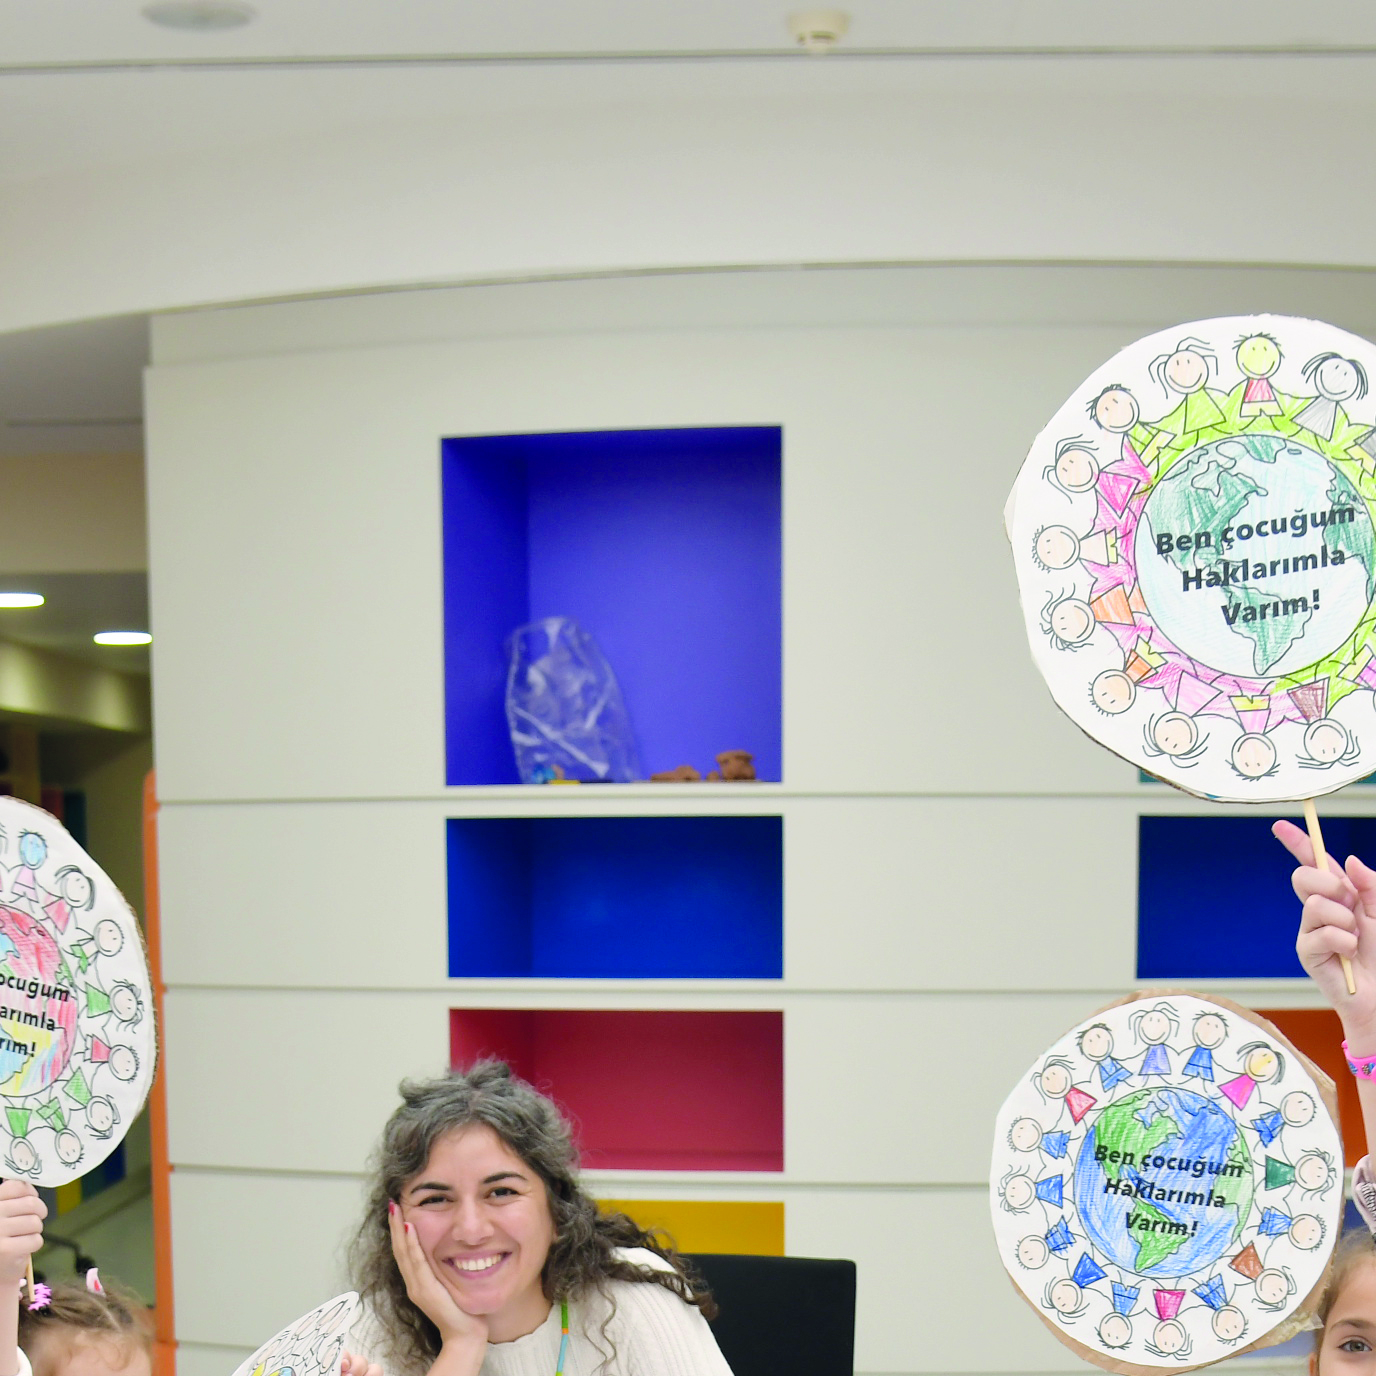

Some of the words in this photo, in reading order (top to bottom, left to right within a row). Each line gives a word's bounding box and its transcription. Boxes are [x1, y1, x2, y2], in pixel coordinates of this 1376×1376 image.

[1155, 530, 1212, 556] Ben
[1221, 507, 1355, 549] çocuğum
[1182, 546, 1346, 592] Haklarımla
[1221, 589, 1321, 626] Varım!
[1094, 1144, 1135, 1167] Ben
[1141, 1152, 1244, 1178] çocuğum
[1103, 1177, 1227, 1209] Haklarımla
[1125, 1211, 1199, 1238] Varım!
